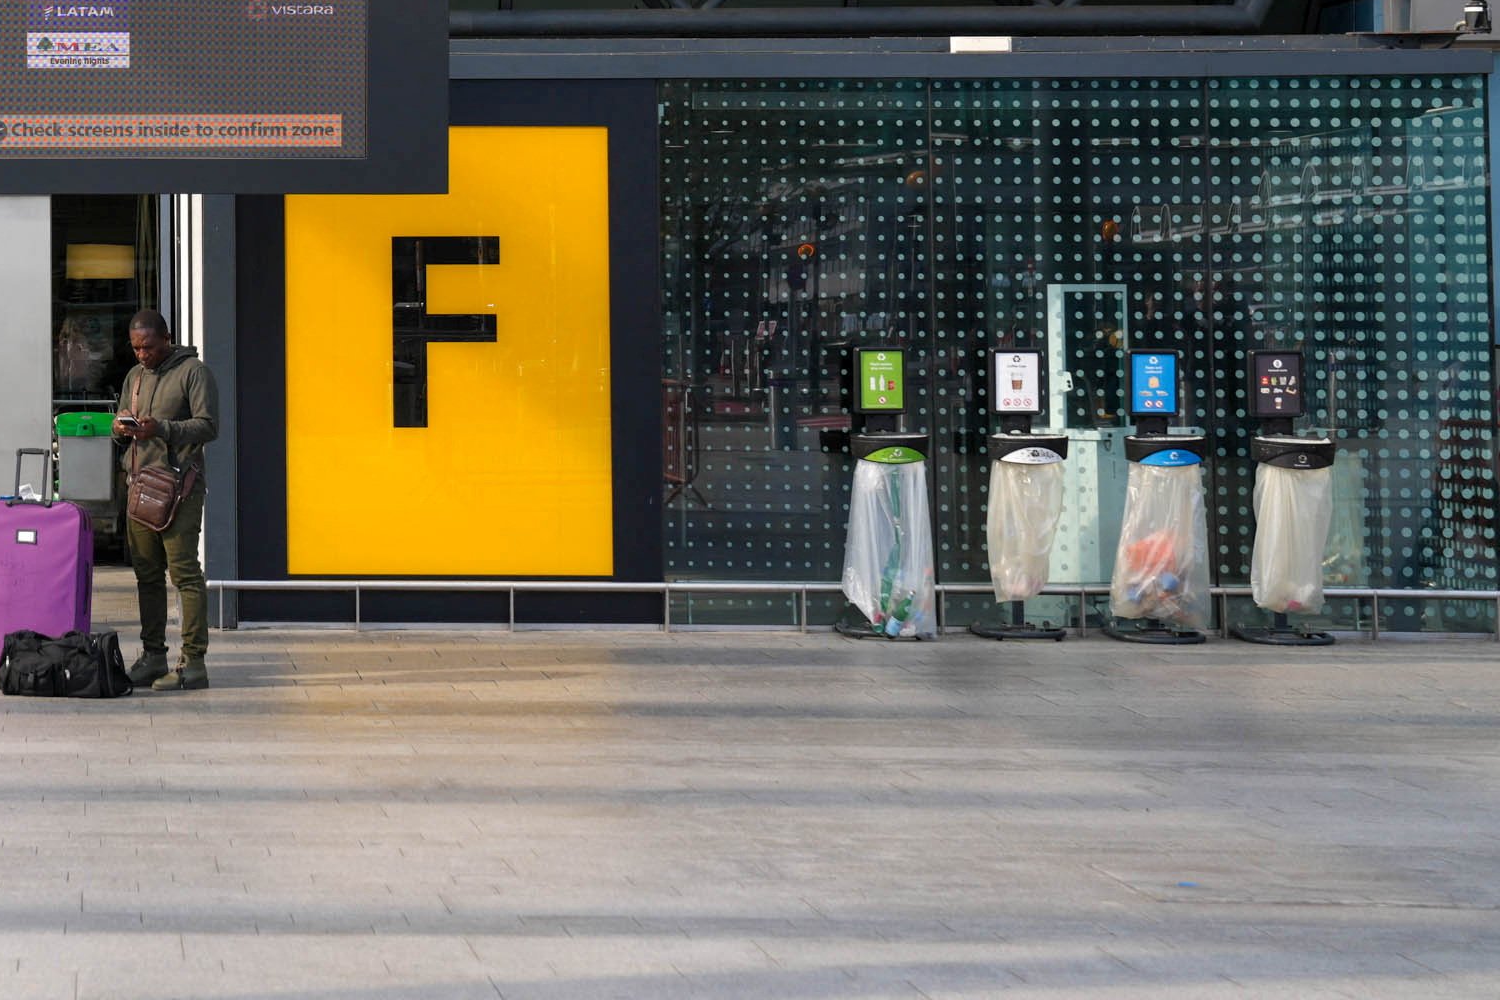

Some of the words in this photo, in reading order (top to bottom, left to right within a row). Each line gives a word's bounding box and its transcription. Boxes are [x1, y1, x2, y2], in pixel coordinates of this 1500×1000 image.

[57, 6, 114, 17] LATAM
[50, 57, 82, 65] Evening
[84, 57, 110, 66] flights
[11, 122, 62, 137] Check
[67, 125, 133, 137] screens
[138, 122, 190, 137] inside
[196, 123, 214, 137] to
[218, 122, 287, 137] confirm
[292, 125, 335, 137] zone
[392, 236, 500, 428] F
